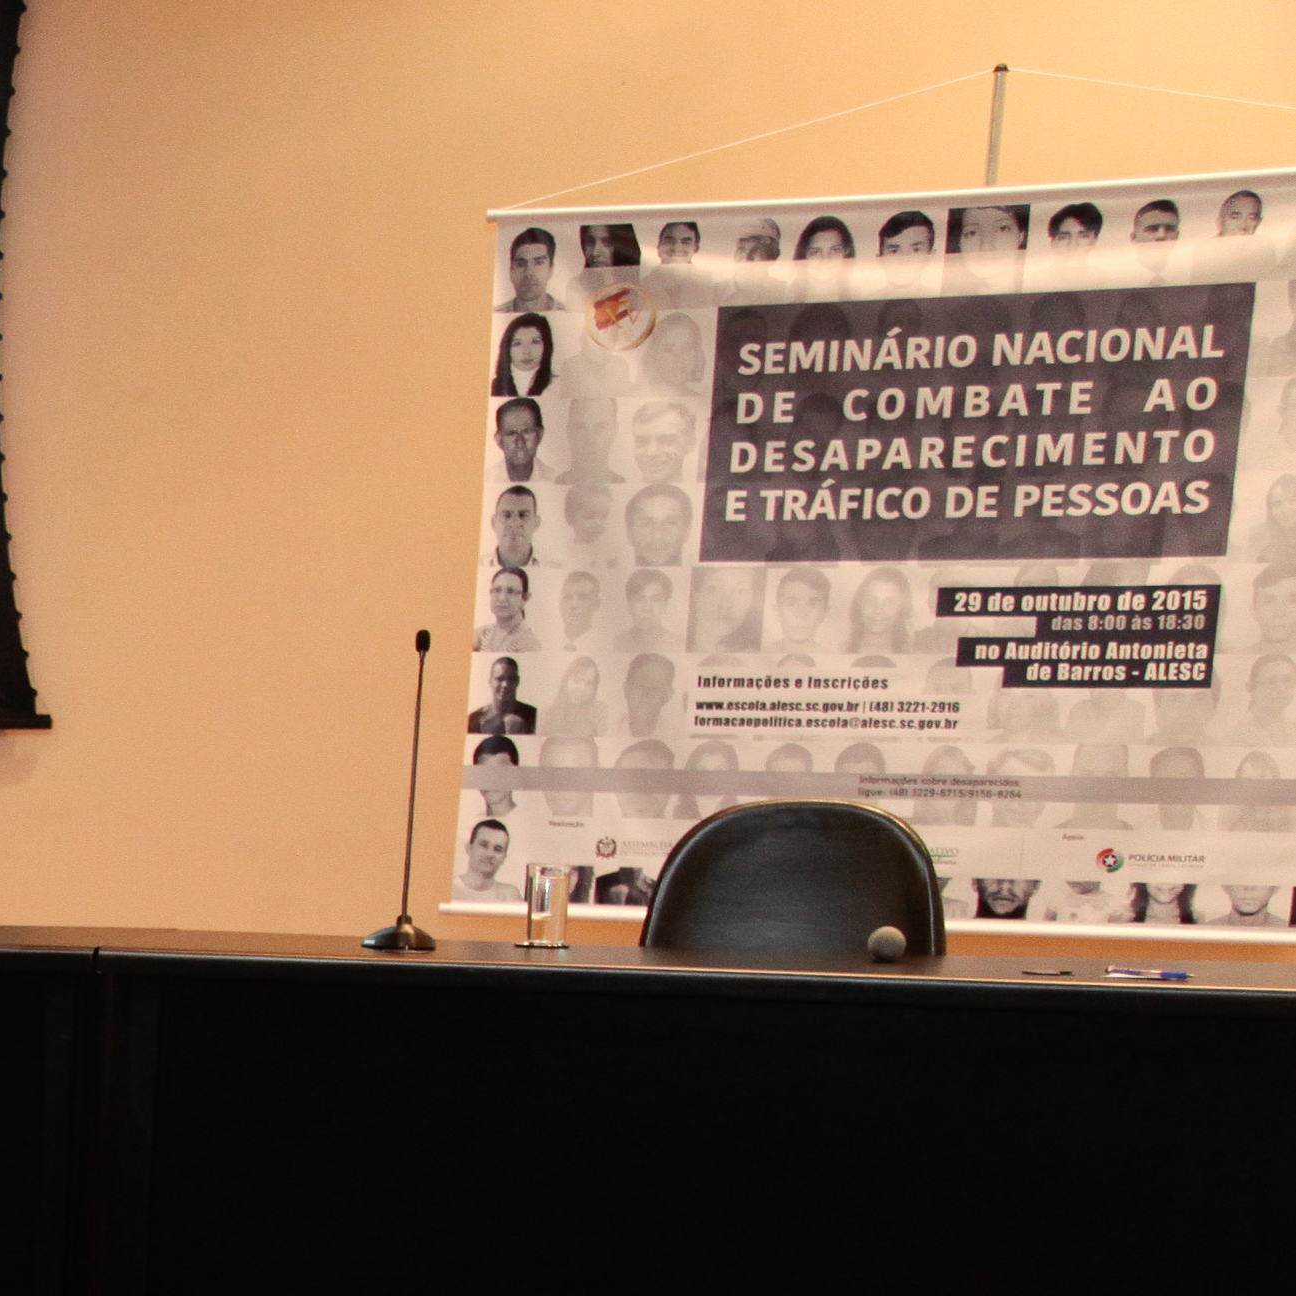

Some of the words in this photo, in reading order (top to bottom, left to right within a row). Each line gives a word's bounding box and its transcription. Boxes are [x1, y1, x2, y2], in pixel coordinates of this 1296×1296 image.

[737, 326, 977, 375] SEMINÁRIO
[992, 324, 1225, 366] NACIONAL
[736, 391, 796, 424] DE
[843, 381, 1094, 421] COMBATE
[1143, 376, 1218, 412] AO
[730, 429, 1216, 473] DESAPARECIMENTO
[725, 490, 748, 521] E
[760, 478, 932, 521] TRÁFICO
[945, 485, 1000, 519] DE
[1014, 480, 1211, 518] PESSOAS
[954, 592, 982, 612] 29
[987, 592, 1015, 612] de
[1021, 592, 1111, 612] outubro
[1117, 591, 1146, 611] de
[1152, 590, 1207, 611] 2015
[1052, 615, 1083, 631] das
[1087, 614, 1127, 631] 8:00
[1131, 614, 1153, 630] às
[1157, 614, 1205, 630] 18:30
[974, 644, 1000, 660] no
[1004, 641, 1102, 660] Auditório
[1105, 641, 1208, 660] Antonieta
[1026, 663, 1052, 681] de
[1057, 663, 1126, 681] Barros
[1144, 661, 1206, 681] ALESC
[697, 675, 790, 690] Informações
[794, 678, 803, 689] e
[807, 676, 889, 690] Inscrições
[695, 700, 860, 714] www.escola.alesc.sc.gov.br
[869, 701, 894, 713] (48)
[897, 701, 961, 713] 3221-2916
[1128, 852, 1166, 863] POLÍCIA
[1167, 854, 1205, 863] MILITAR
